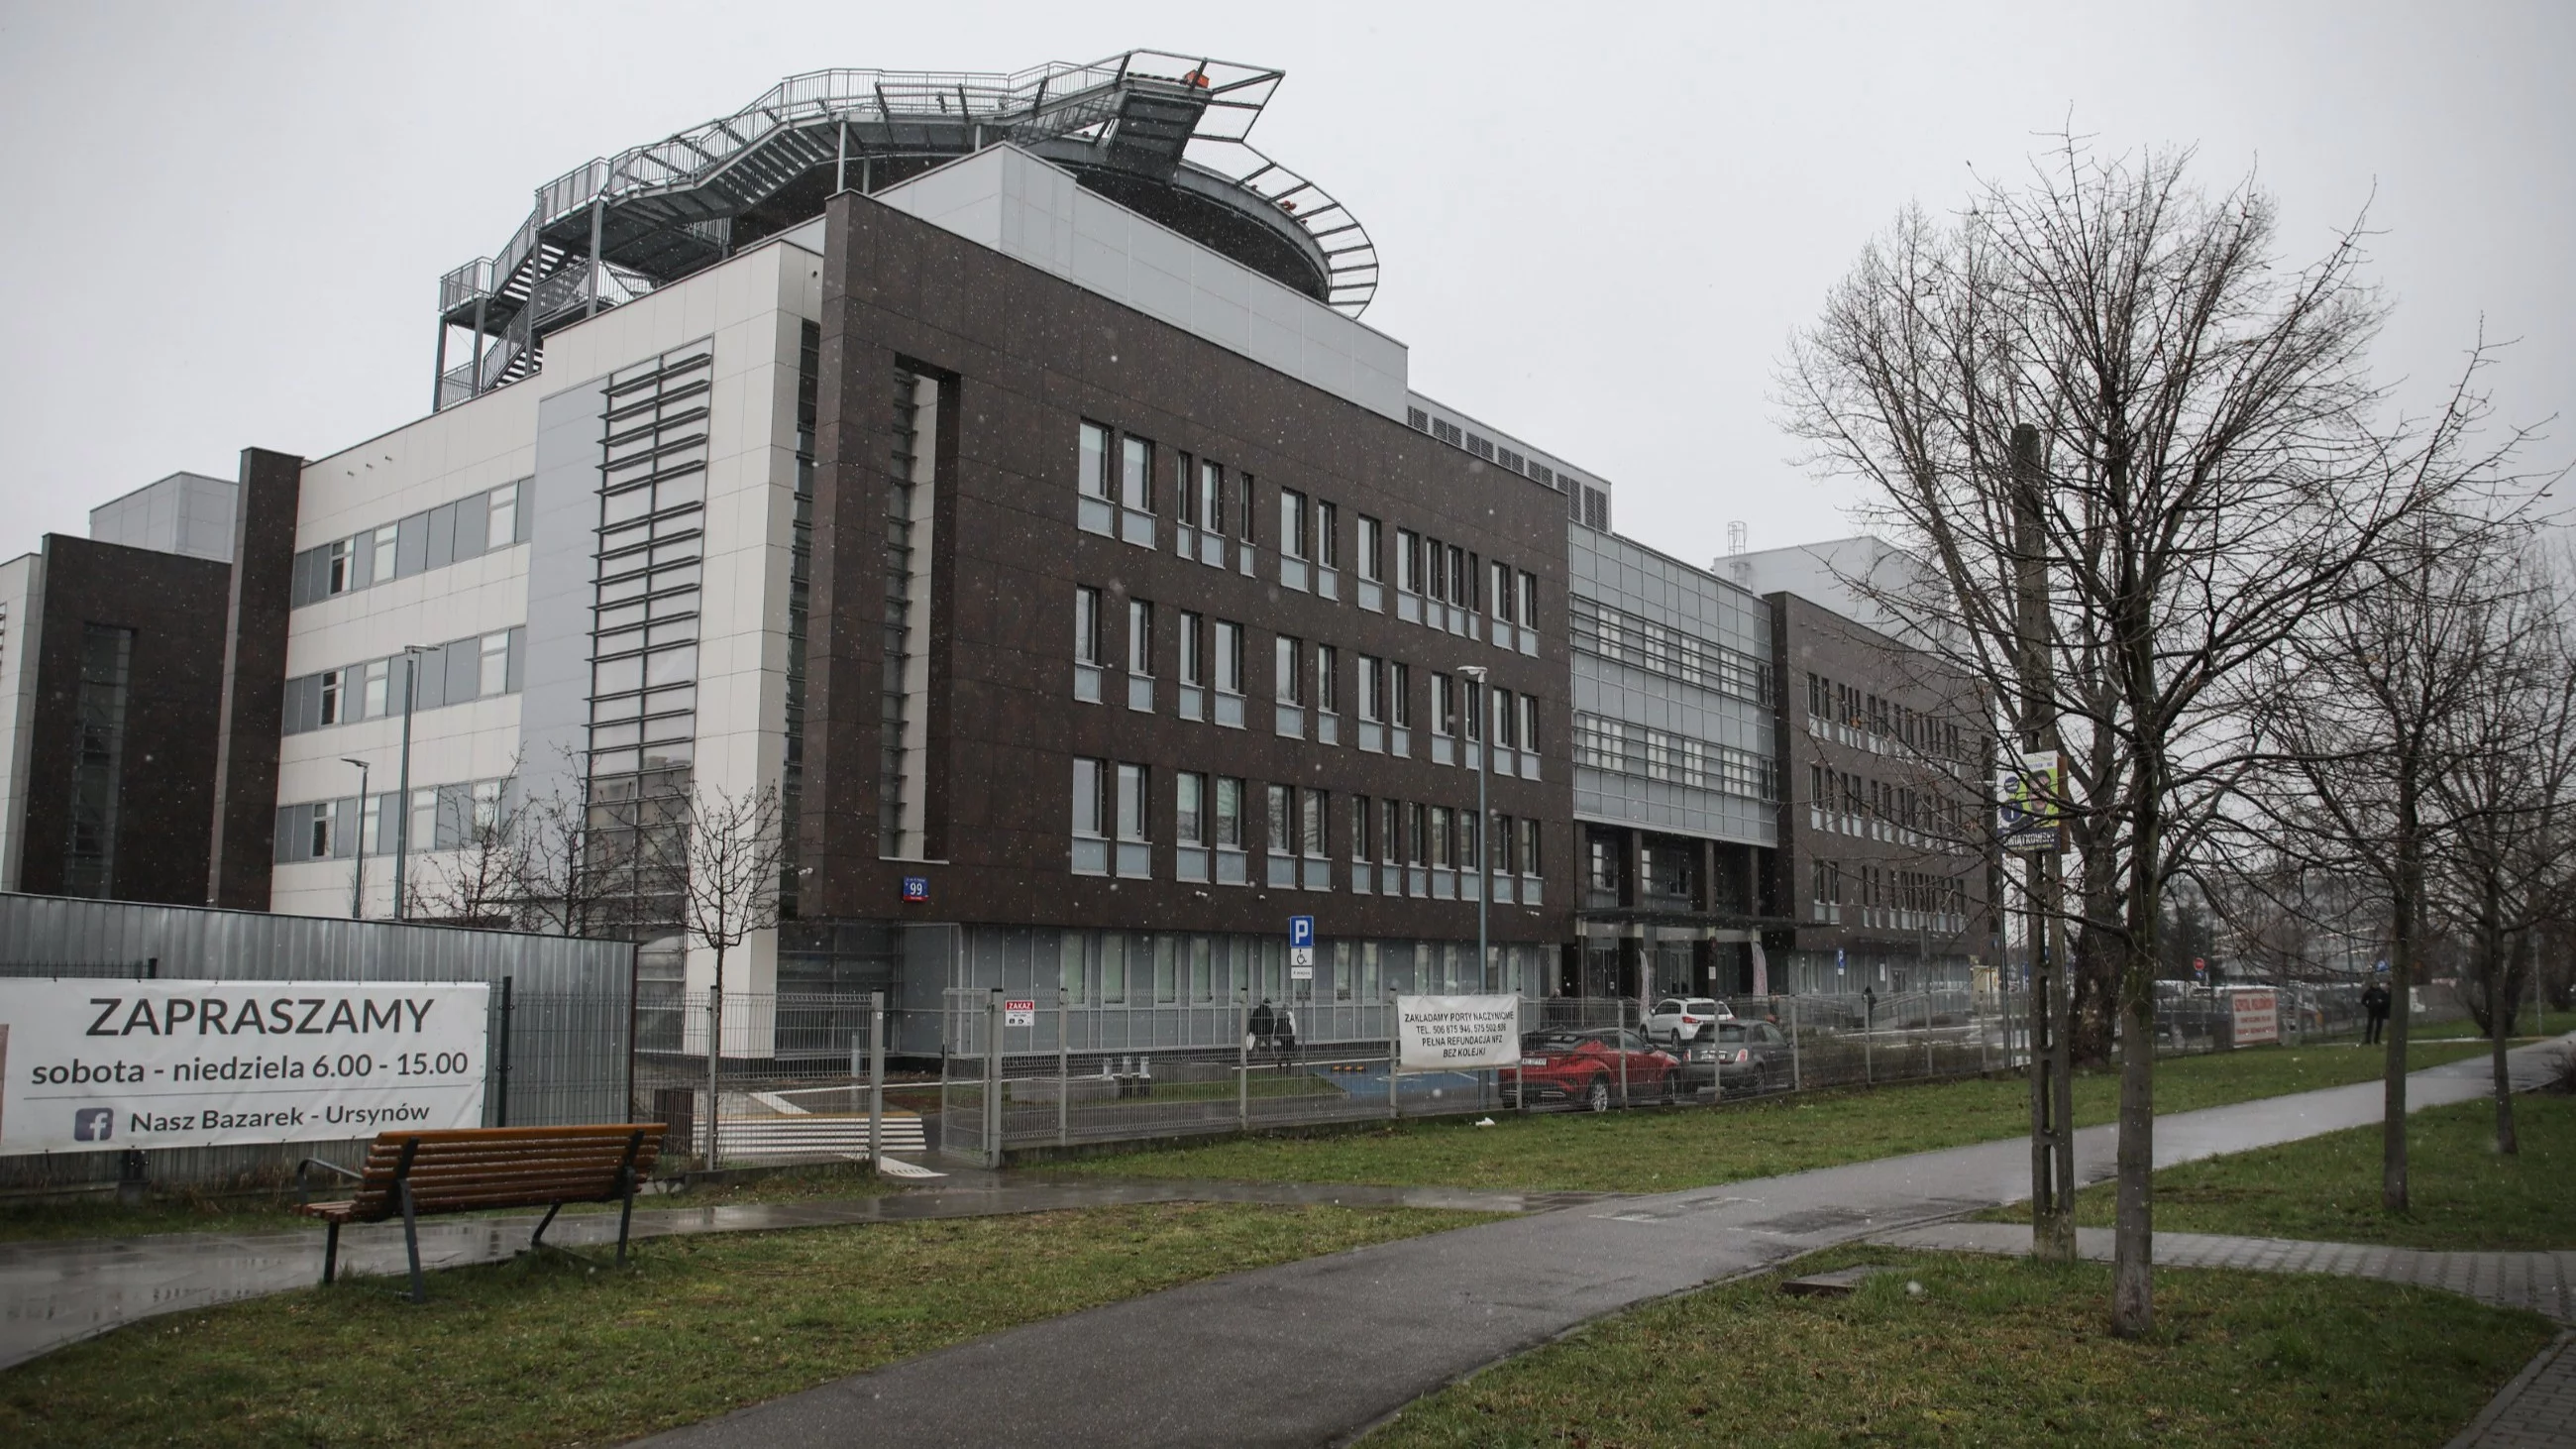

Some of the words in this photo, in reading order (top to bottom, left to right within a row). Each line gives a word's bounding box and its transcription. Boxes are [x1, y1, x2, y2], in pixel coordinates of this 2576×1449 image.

[910, 882, 922, 896] 99
[1295, 920, 1309, 944] P
[85, 998, 435, 1036] ZAPRASZAMY
[1450, 1012, 1472, 1022] PORTY
[1433, 1025, 1445, 1034] 506
[1447, 1025, 1457, 1034] 875
[1473, 1024, 1484, 1033] 575
[1485, 1023, 1496, 1032] 502
[1422, 1037, 1446, 1047] PEŁNA
[1447, 1036, 1491, 1046] REFUNDACJA
[1491, 1035, 1503, 1044] NFZ
[1443, 1049, 1456, 1058] BEZ
[1457, 1047, 1486, 1058] KOLEJKI
[32, 1059, 145, 1085] sobota
[172, 1055, 304, 1082] niedziela
[312, 1054, 372, 1077] 6.00
[397, 1052, 468, 1075] 15.00
[131, 1112, 194, 1133] Nasz
[202, 1106, 303, 1130] Bazarek
[326, 1103, 430, 1127] Ursynów
